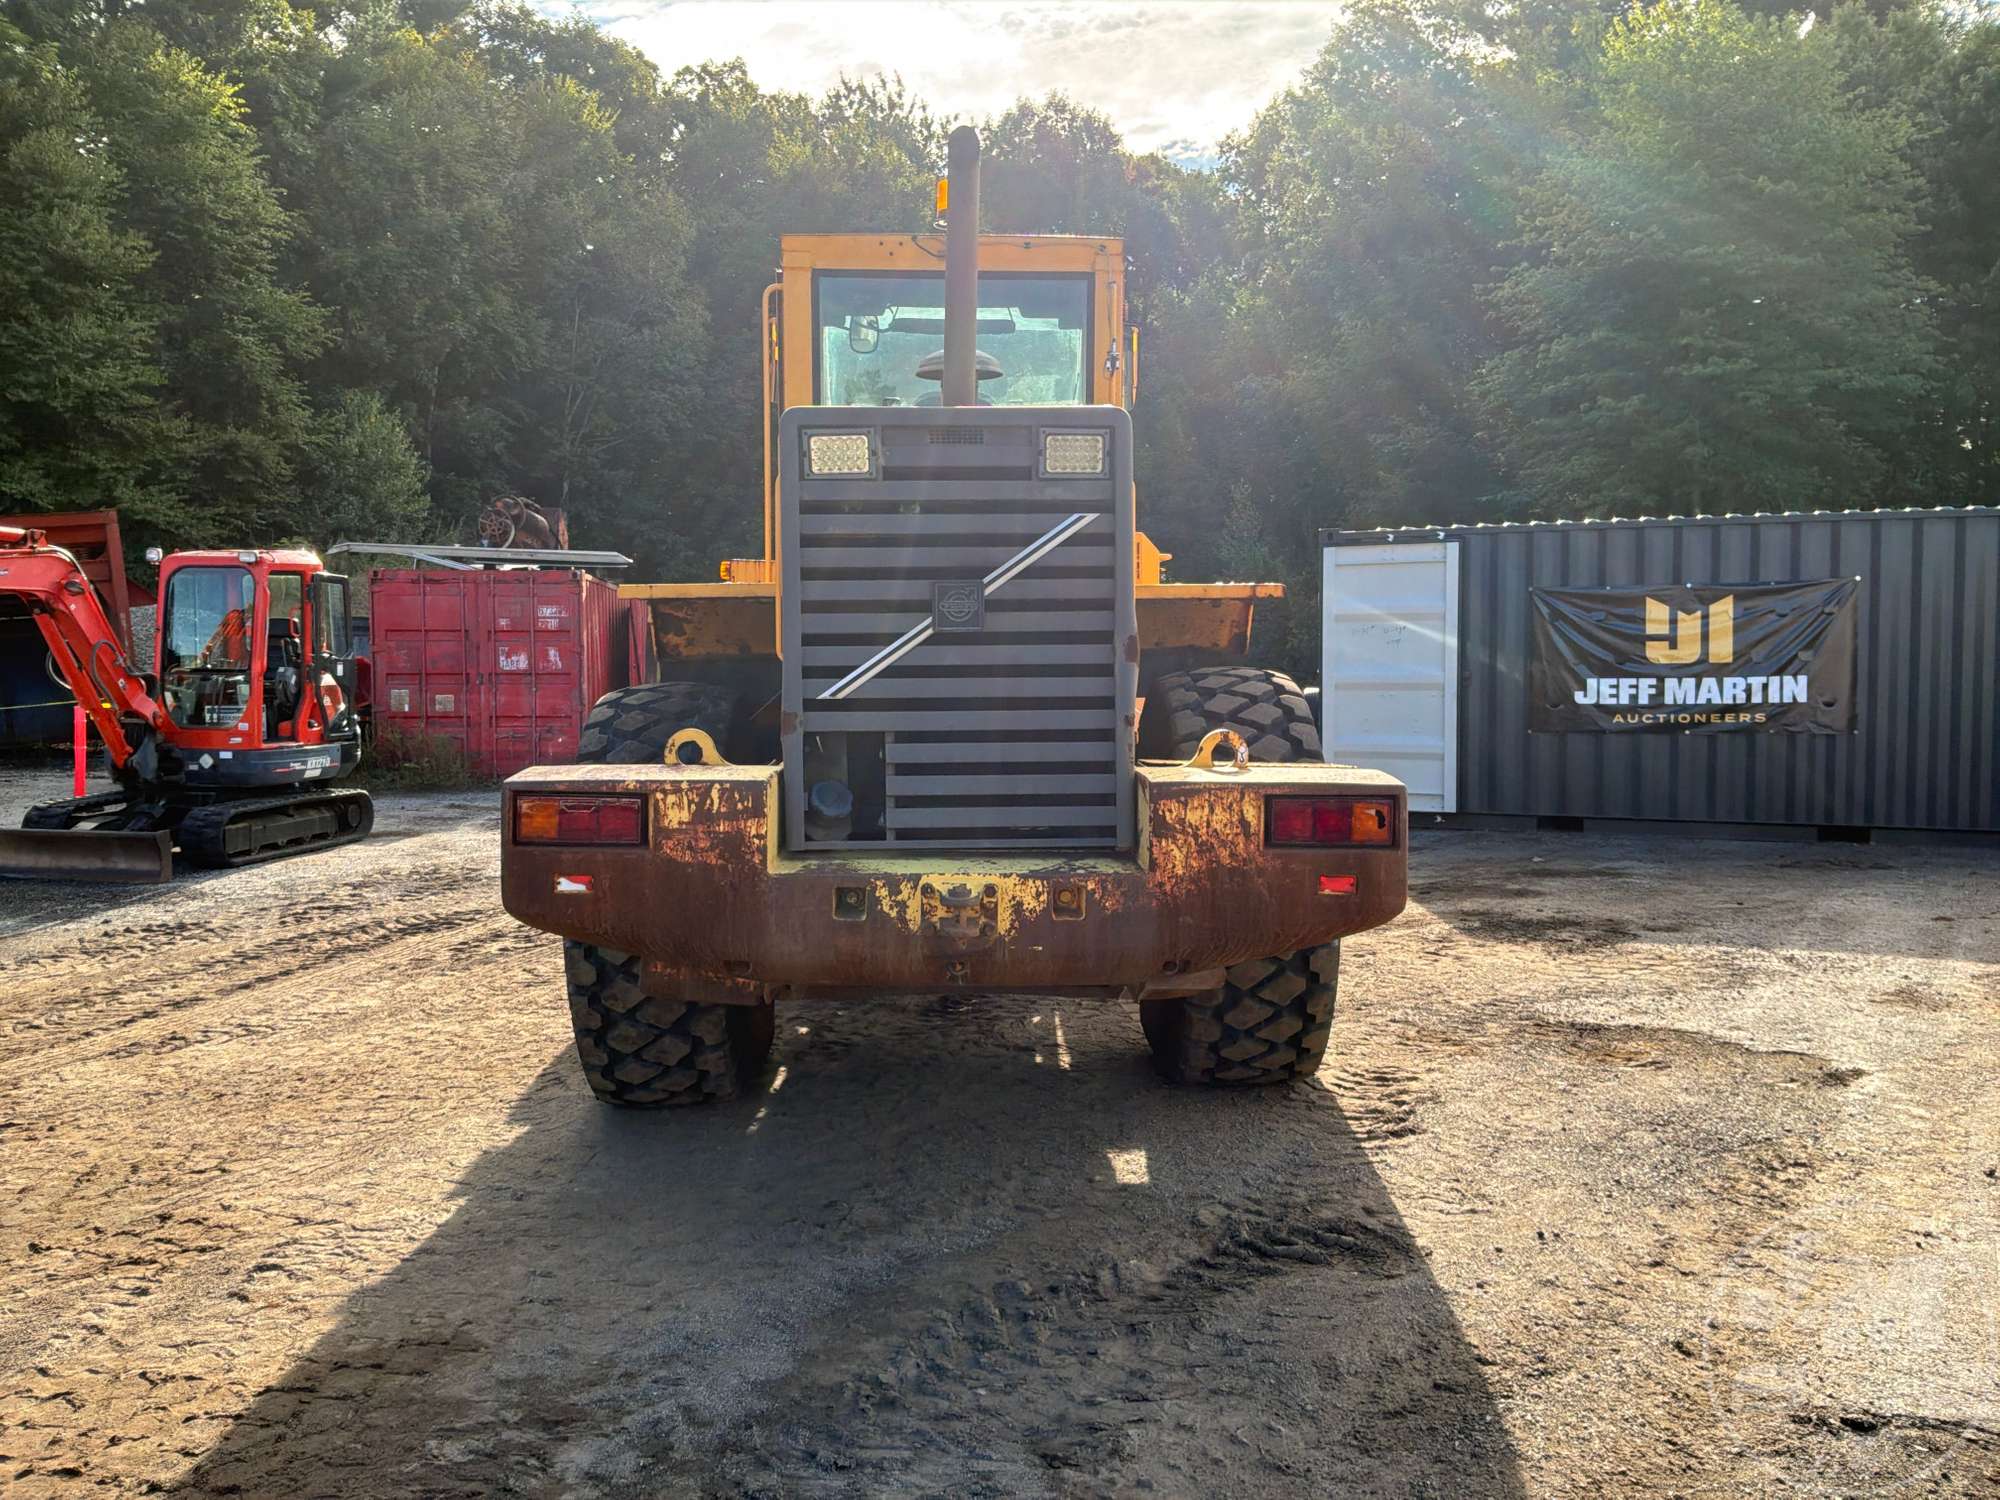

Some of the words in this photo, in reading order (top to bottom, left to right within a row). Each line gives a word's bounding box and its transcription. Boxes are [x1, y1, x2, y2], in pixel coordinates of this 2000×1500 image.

[1574, 677, 1657, 705] JEFF
[1664, 675, 1808, 705] MARTIN
[1612, 712, 1768, 724] AUCTIONEERS
